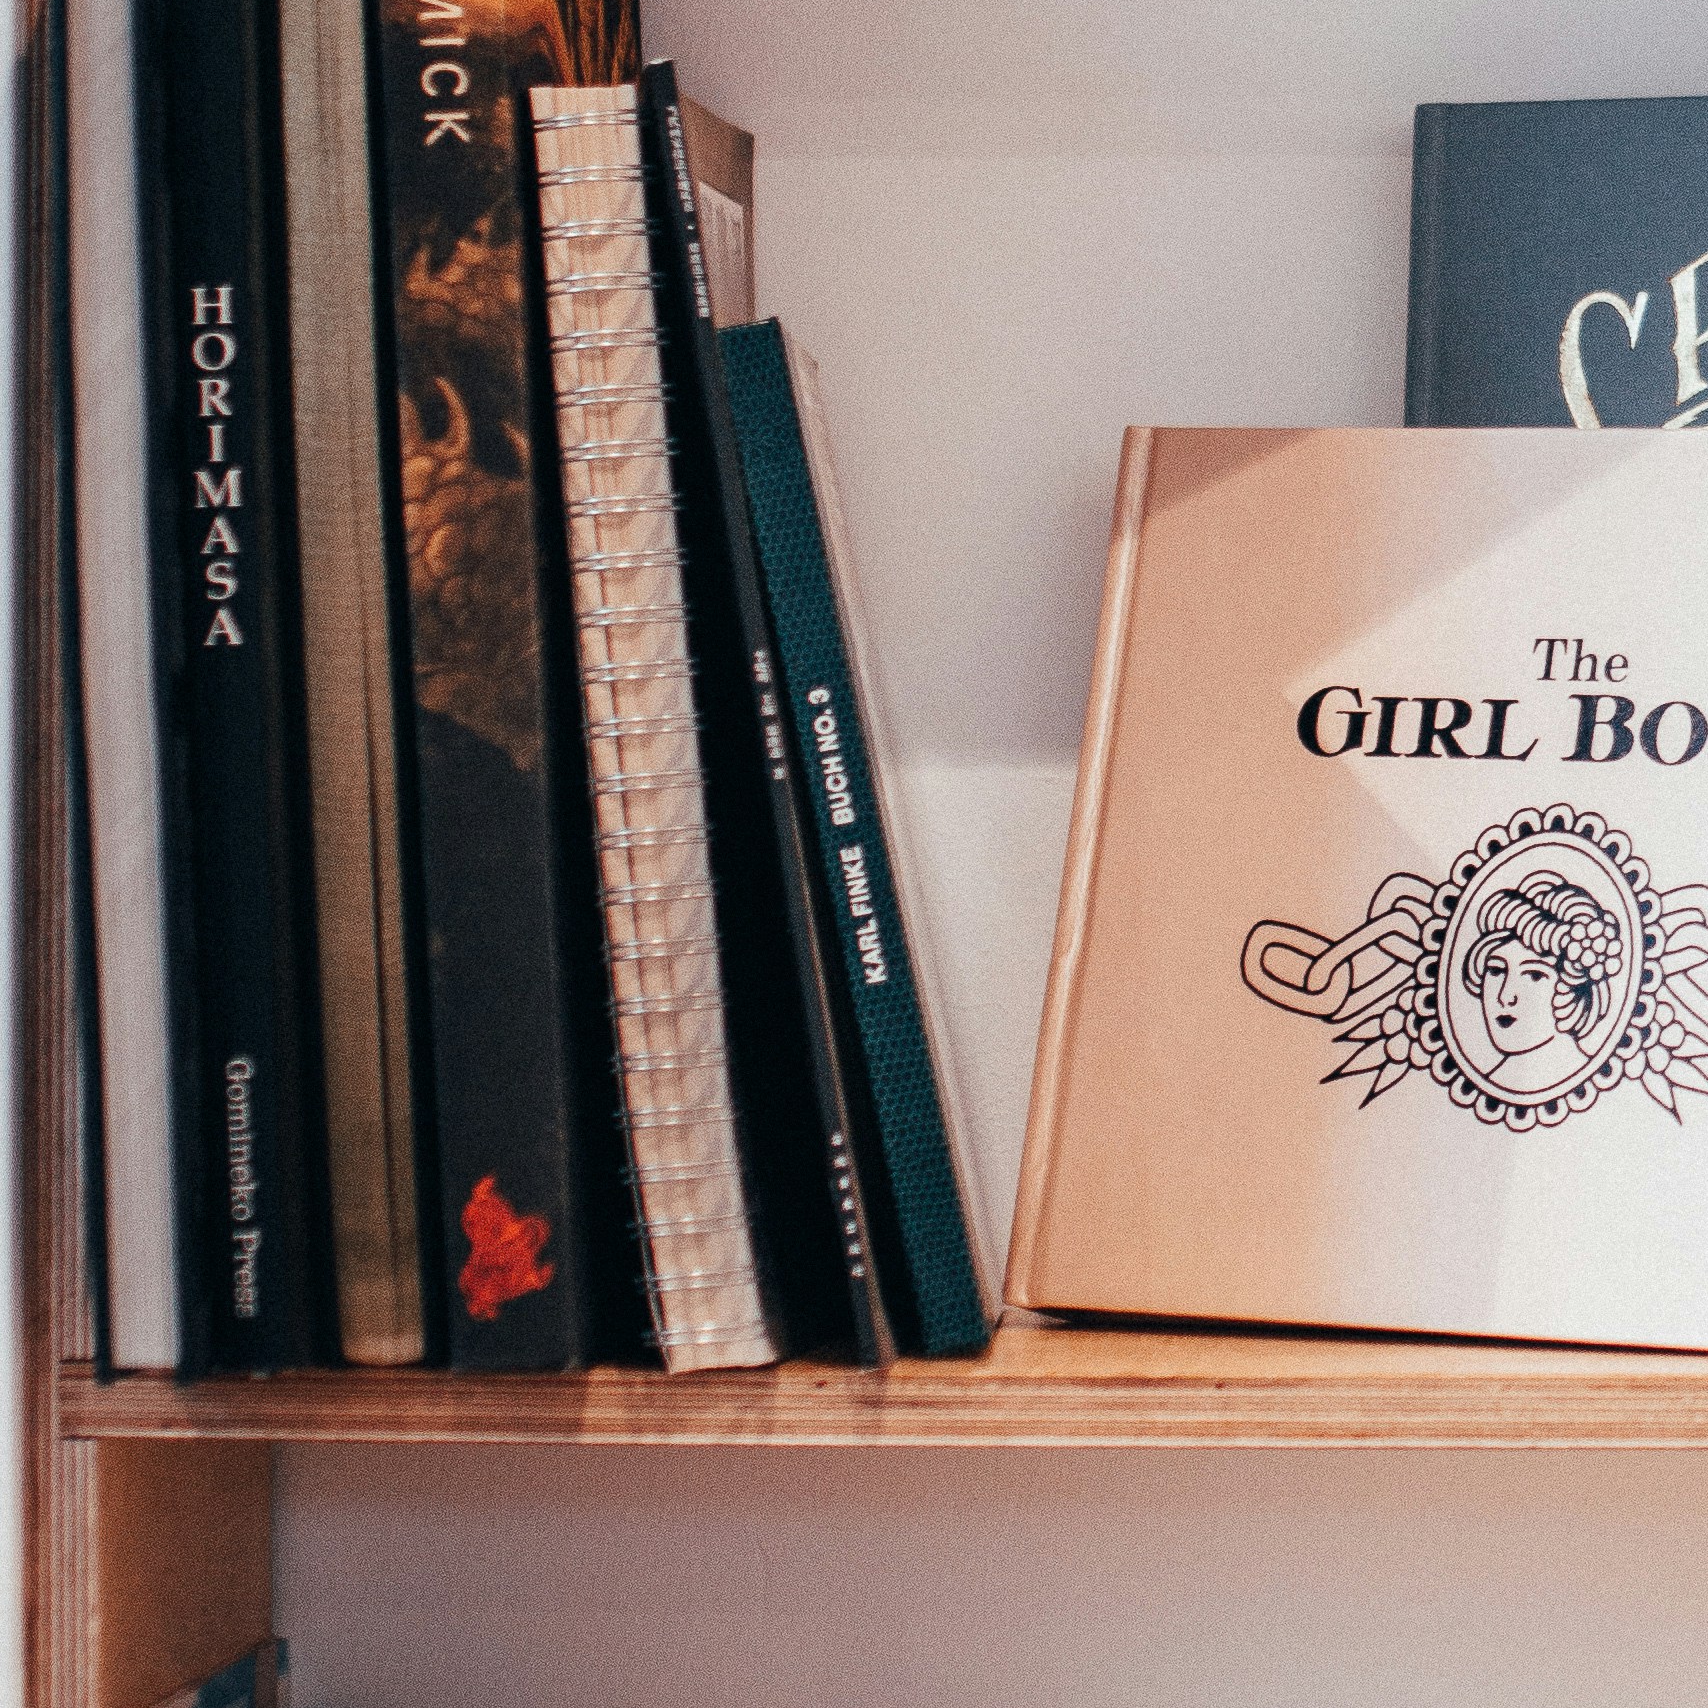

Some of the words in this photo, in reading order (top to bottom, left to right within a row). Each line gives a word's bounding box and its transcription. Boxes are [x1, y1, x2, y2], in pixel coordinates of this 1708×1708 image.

[190, 285, 246, 648] HORIMASA
[1533, 636, 1630, 686] The
[805, 689, 830, 705] 3
[1296, 685, 1542, 764] GIRL
[813, 713, 846, 760] NO.
[820, 765, 857, 826] BUCH
[837, 845, 873, 929] FINKE
[852, 934, 889, 985] KARL
[223, 1058, 260, 1223] Gomineko
[229, 1230, 264, 1317] Press
